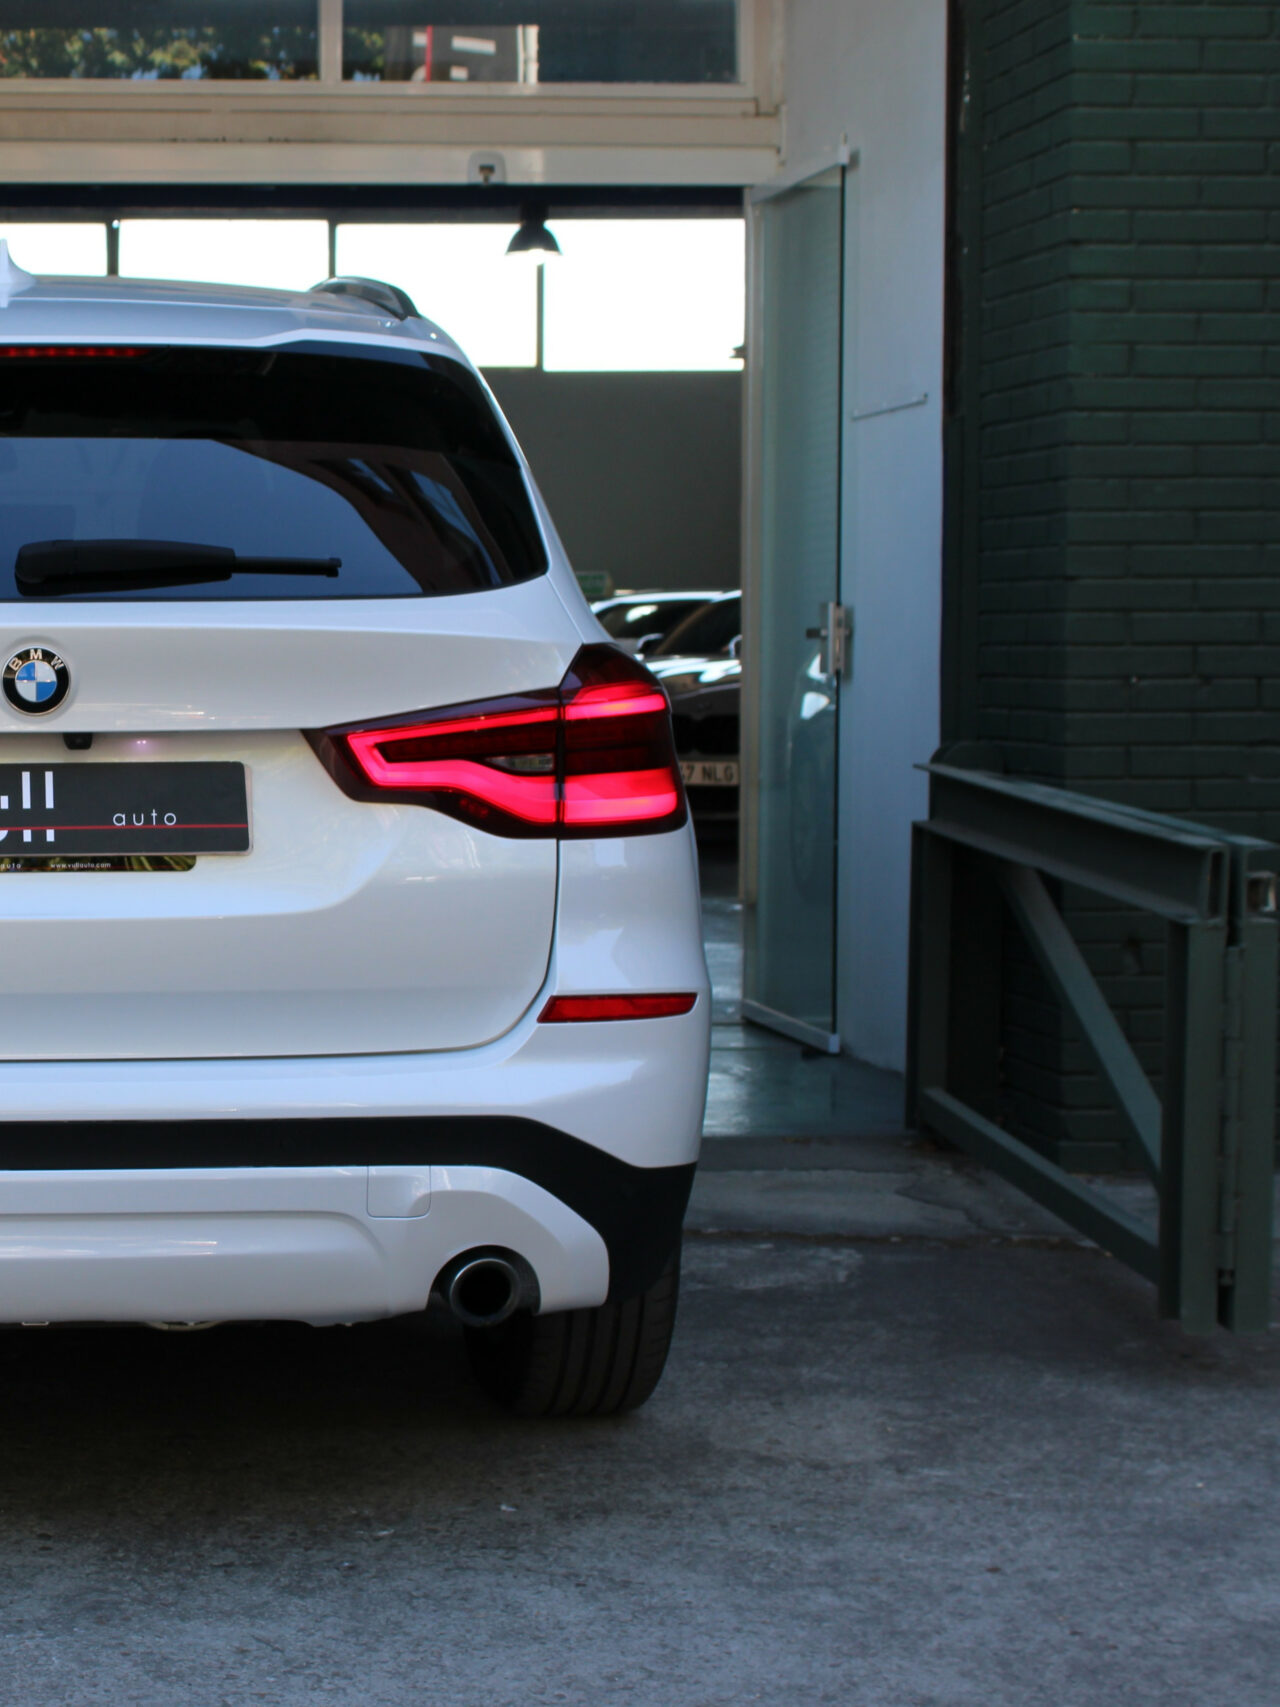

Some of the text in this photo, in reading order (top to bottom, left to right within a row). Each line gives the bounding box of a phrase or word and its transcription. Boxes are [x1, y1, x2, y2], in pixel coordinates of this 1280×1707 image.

[8, 648, 65, 671] BMW
[112, 809, 177, 826] auto
[0, 861, 22, 869] auto
[50, 861, 111, 869] www.vullauto.com
